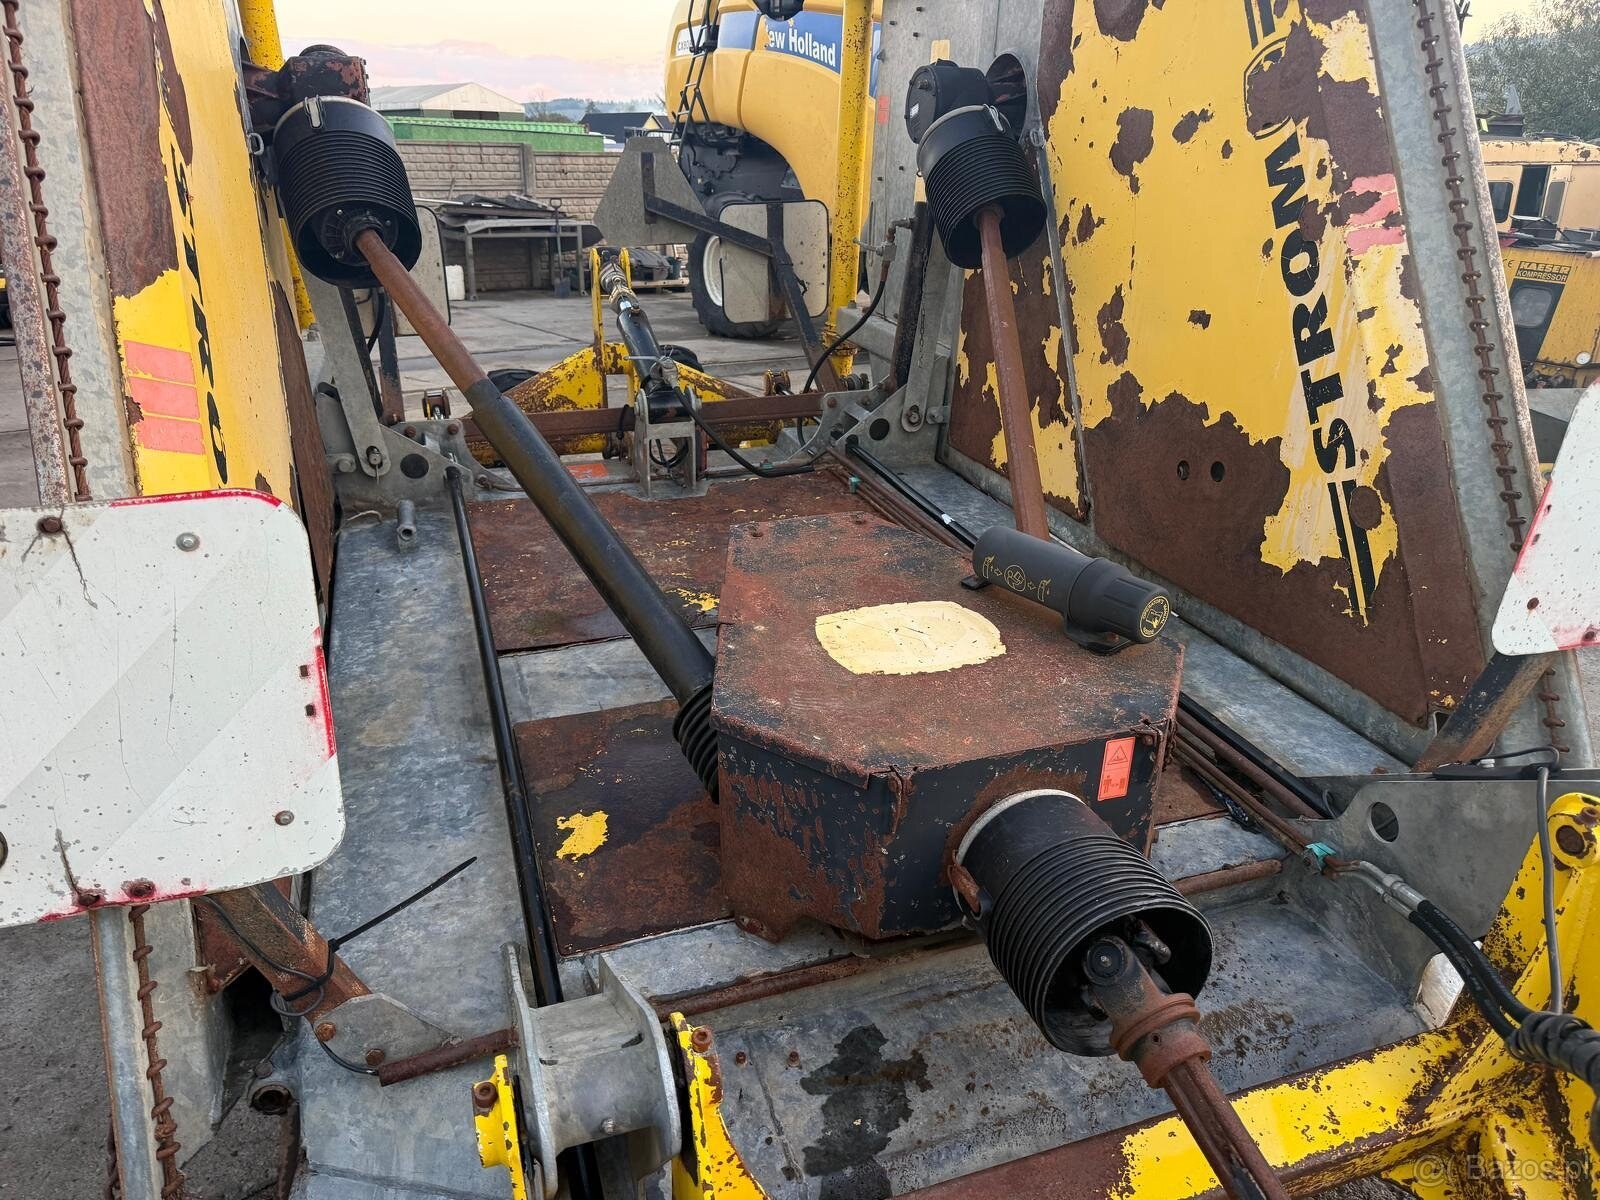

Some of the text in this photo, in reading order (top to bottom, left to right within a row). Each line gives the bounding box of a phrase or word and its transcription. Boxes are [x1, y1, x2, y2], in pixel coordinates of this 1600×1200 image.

[767, 28, 836, 67] ew Holland
[1516, 269, 1568, 282] KOMPRESSOR
[1520, 261, 1571, 274] KAESER
[171, 143, 228, 487] STRO
[1264, 132, 1356, 476] STROM
